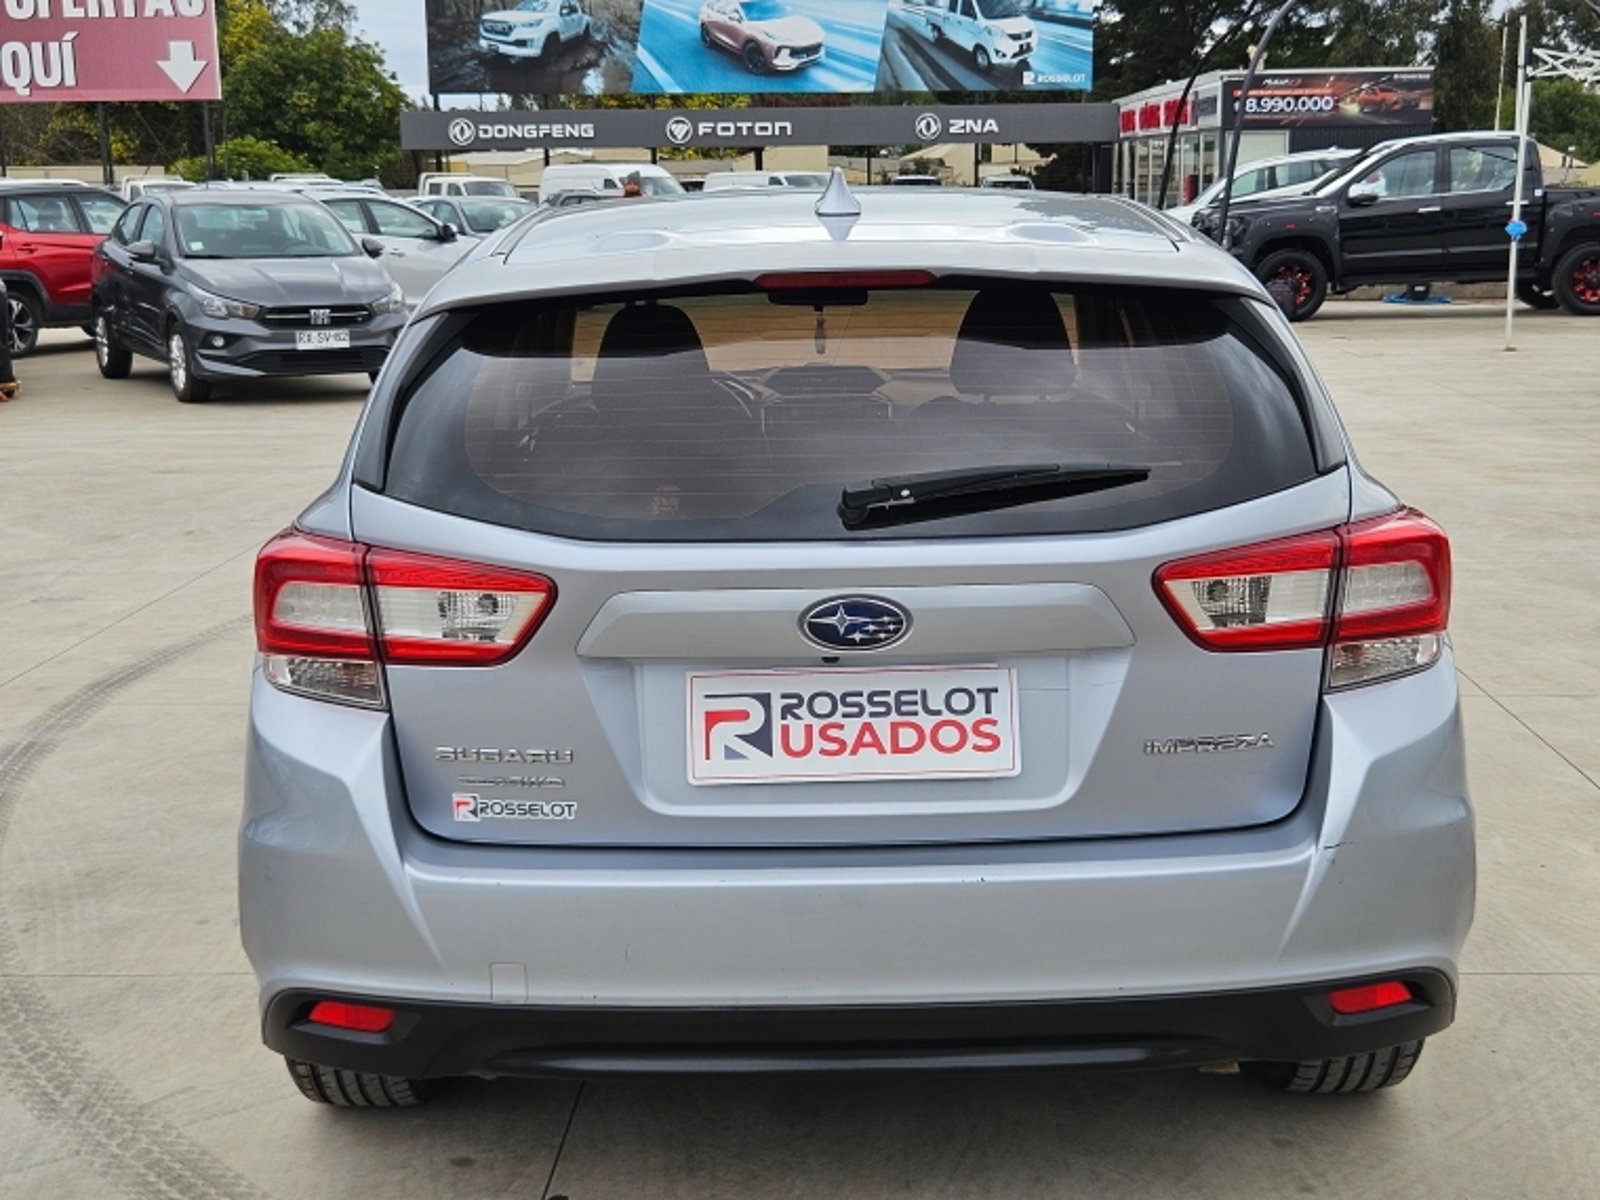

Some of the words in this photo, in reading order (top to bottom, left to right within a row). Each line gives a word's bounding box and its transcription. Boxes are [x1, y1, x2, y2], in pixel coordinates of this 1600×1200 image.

[478, 123, 595, 138] DONGFENG
[698, 121, 792, 136] FOTON
[948, 119, 999, 134] ZNA
[780, 687, 999, 720] ROSSELOT
[780, 718, 1001, 758] USADOS
[1144, 732, 1274, 755] IMPREZA
[434, 745, 574, 764] SUBARU
[479, 801, 576, 818] ROSSELOT
